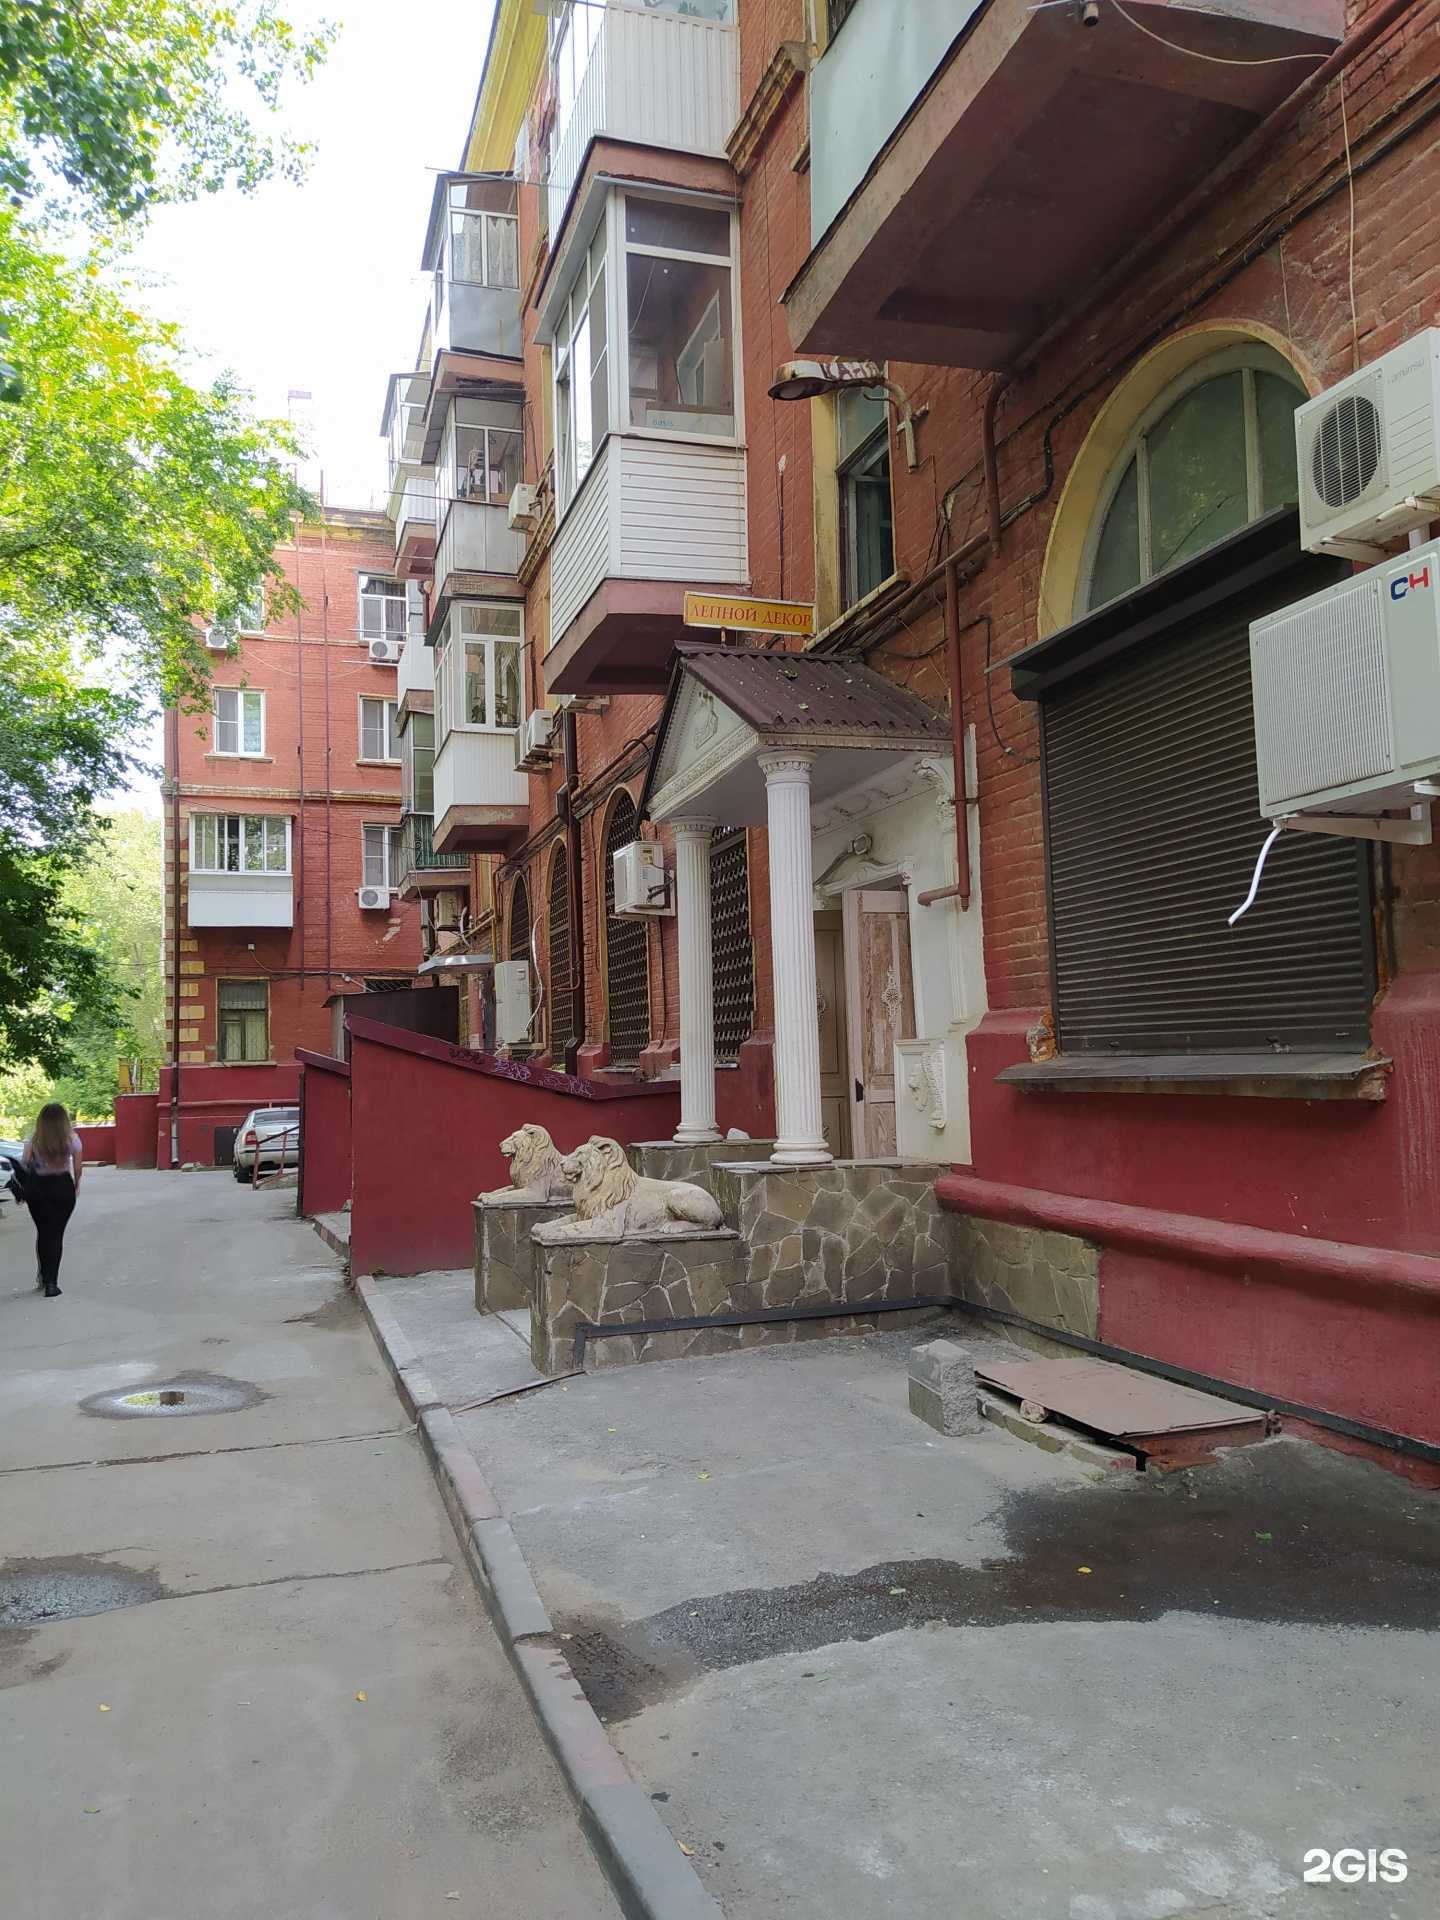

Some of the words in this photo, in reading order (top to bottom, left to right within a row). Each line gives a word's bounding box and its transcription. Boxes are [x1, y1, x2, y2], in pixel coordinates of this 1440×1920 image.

[1391, 567, 1429, 601] CH
[692, 603, 758, 622] ЛЕПНОЙ
[762, 610, 811, 627] ДЕКОР
